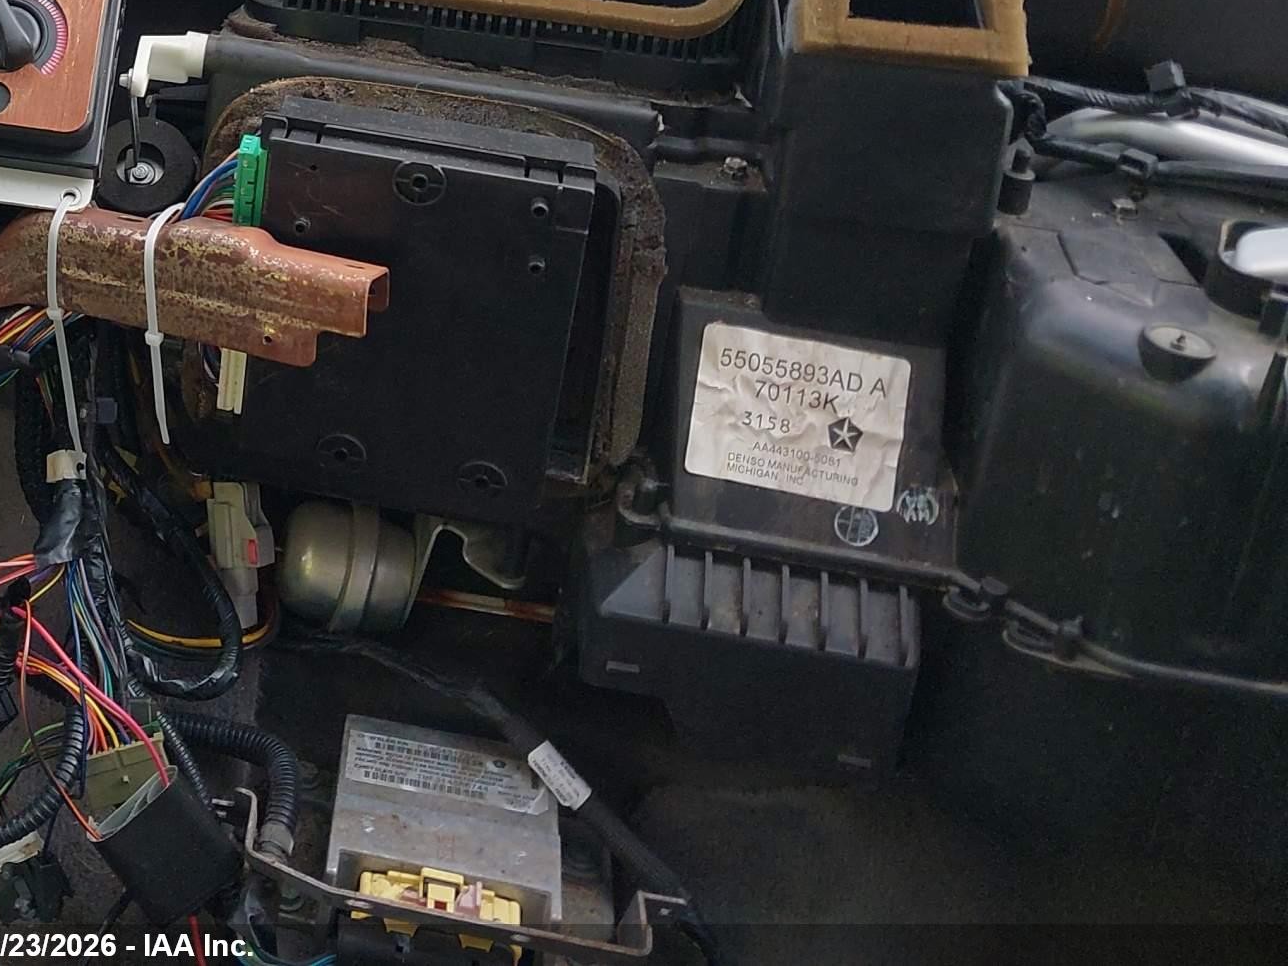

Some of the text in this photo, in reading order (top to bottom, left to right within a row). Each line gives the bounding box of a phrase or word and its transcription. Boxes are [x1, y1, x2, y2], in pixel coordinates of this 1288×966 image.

[720, 347, 887, 399] 55055893AD A
[755, 379, 840, 414] 70113K
[741, 410, 791, 434] 3158
[727, 452, 859, 487] DENSO MANUFACTURING
